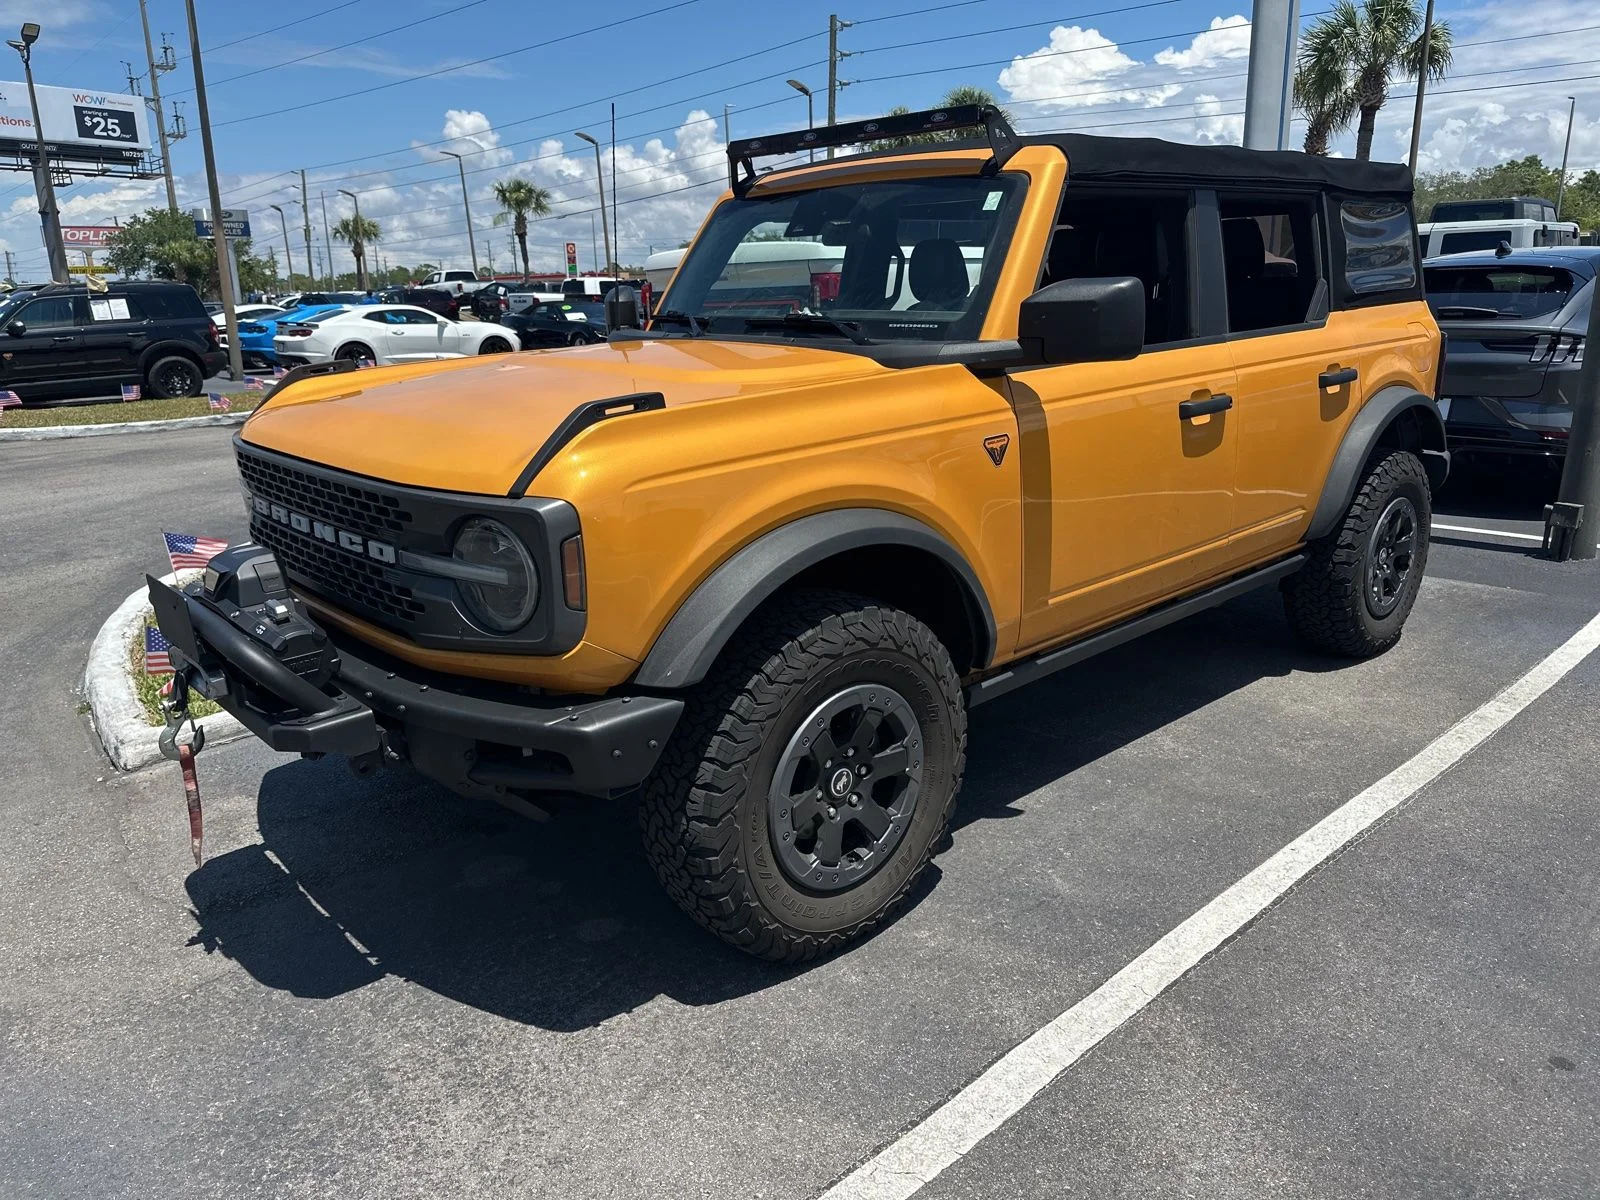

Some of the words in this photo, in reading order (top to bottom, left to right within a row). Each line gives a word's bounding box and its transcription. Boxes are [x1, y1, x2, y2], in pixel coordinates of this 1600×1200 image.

[72, 94, 106, 105] WOW!
[84, 115, 121, 137] $25
[253, 496, 396, 564] BRONCO
